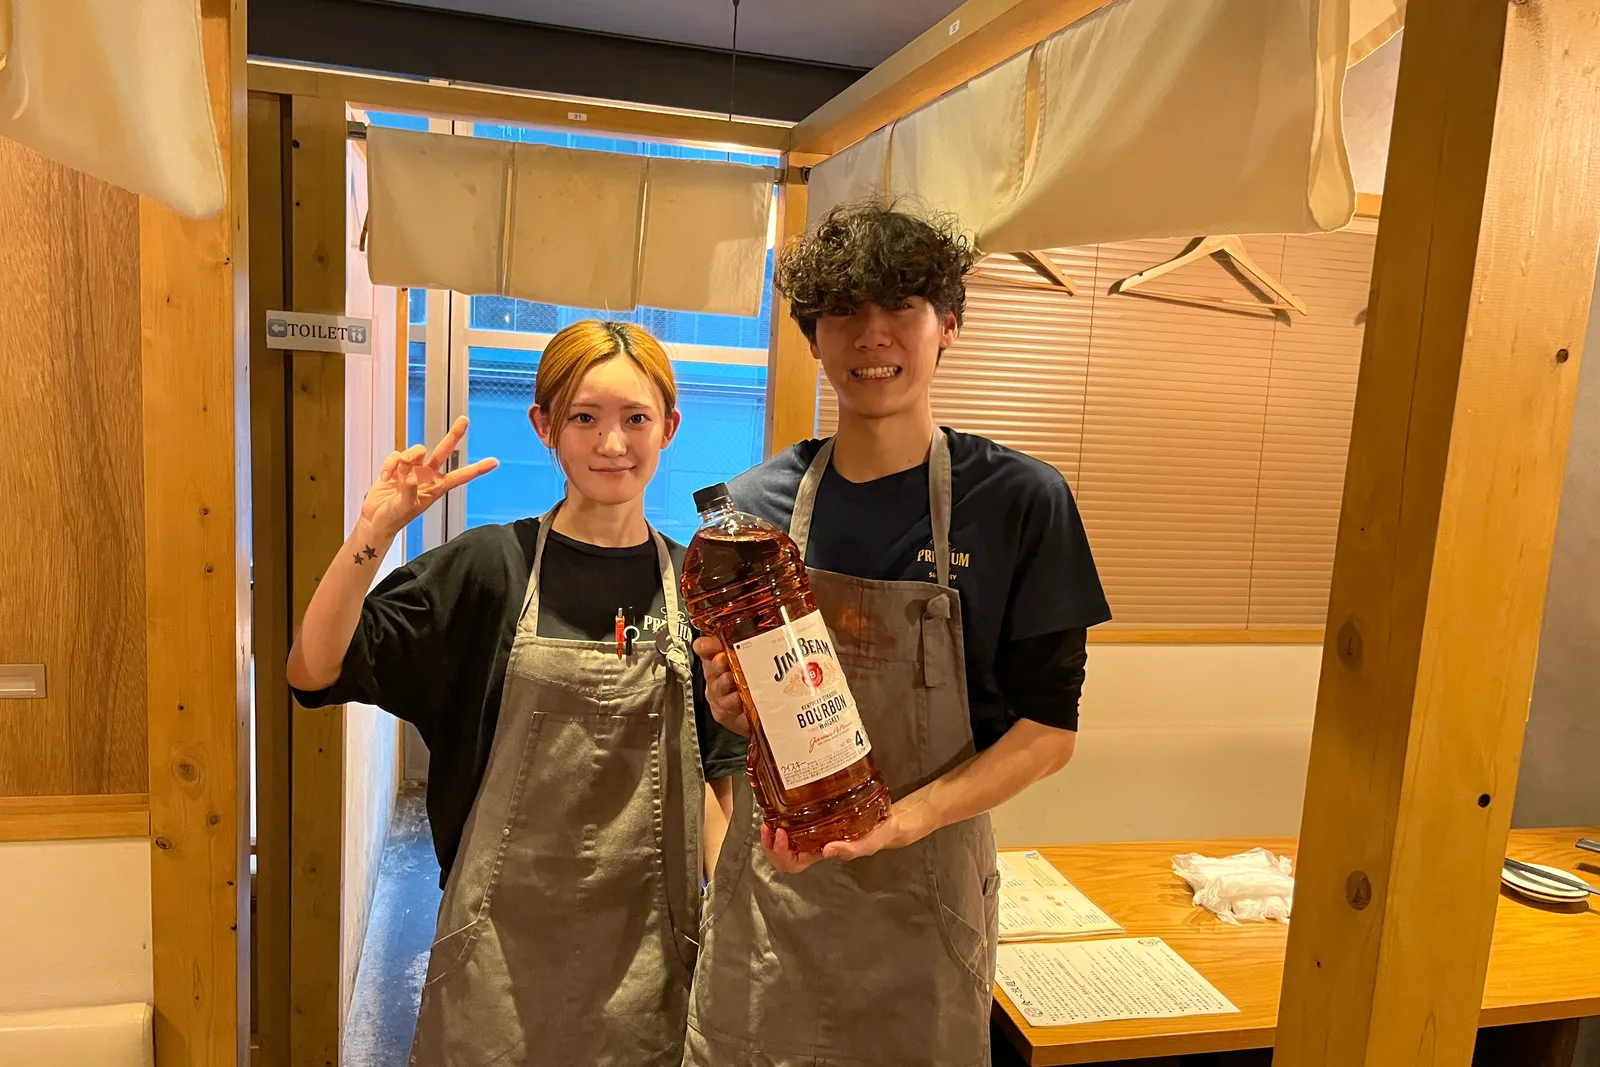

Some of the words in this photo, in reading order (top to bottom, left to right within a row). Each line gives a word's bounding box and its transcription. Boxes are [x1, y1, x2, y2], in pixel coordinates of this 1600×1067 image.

[288, 323, 348, 340] TOILET
[917, 549, 970, 568] PRUM
[928, 571, 957, 580] SURY
[773, 647, 799, 683] JIM
[798, 637, 834, 660] BEAM
[797, 694, 848, 729] BOURBON
[818, 715, 840, 730] WHISKEY
[855, 730, 864, 747] 4
[781, 761, 807, 774] ウイスキー
